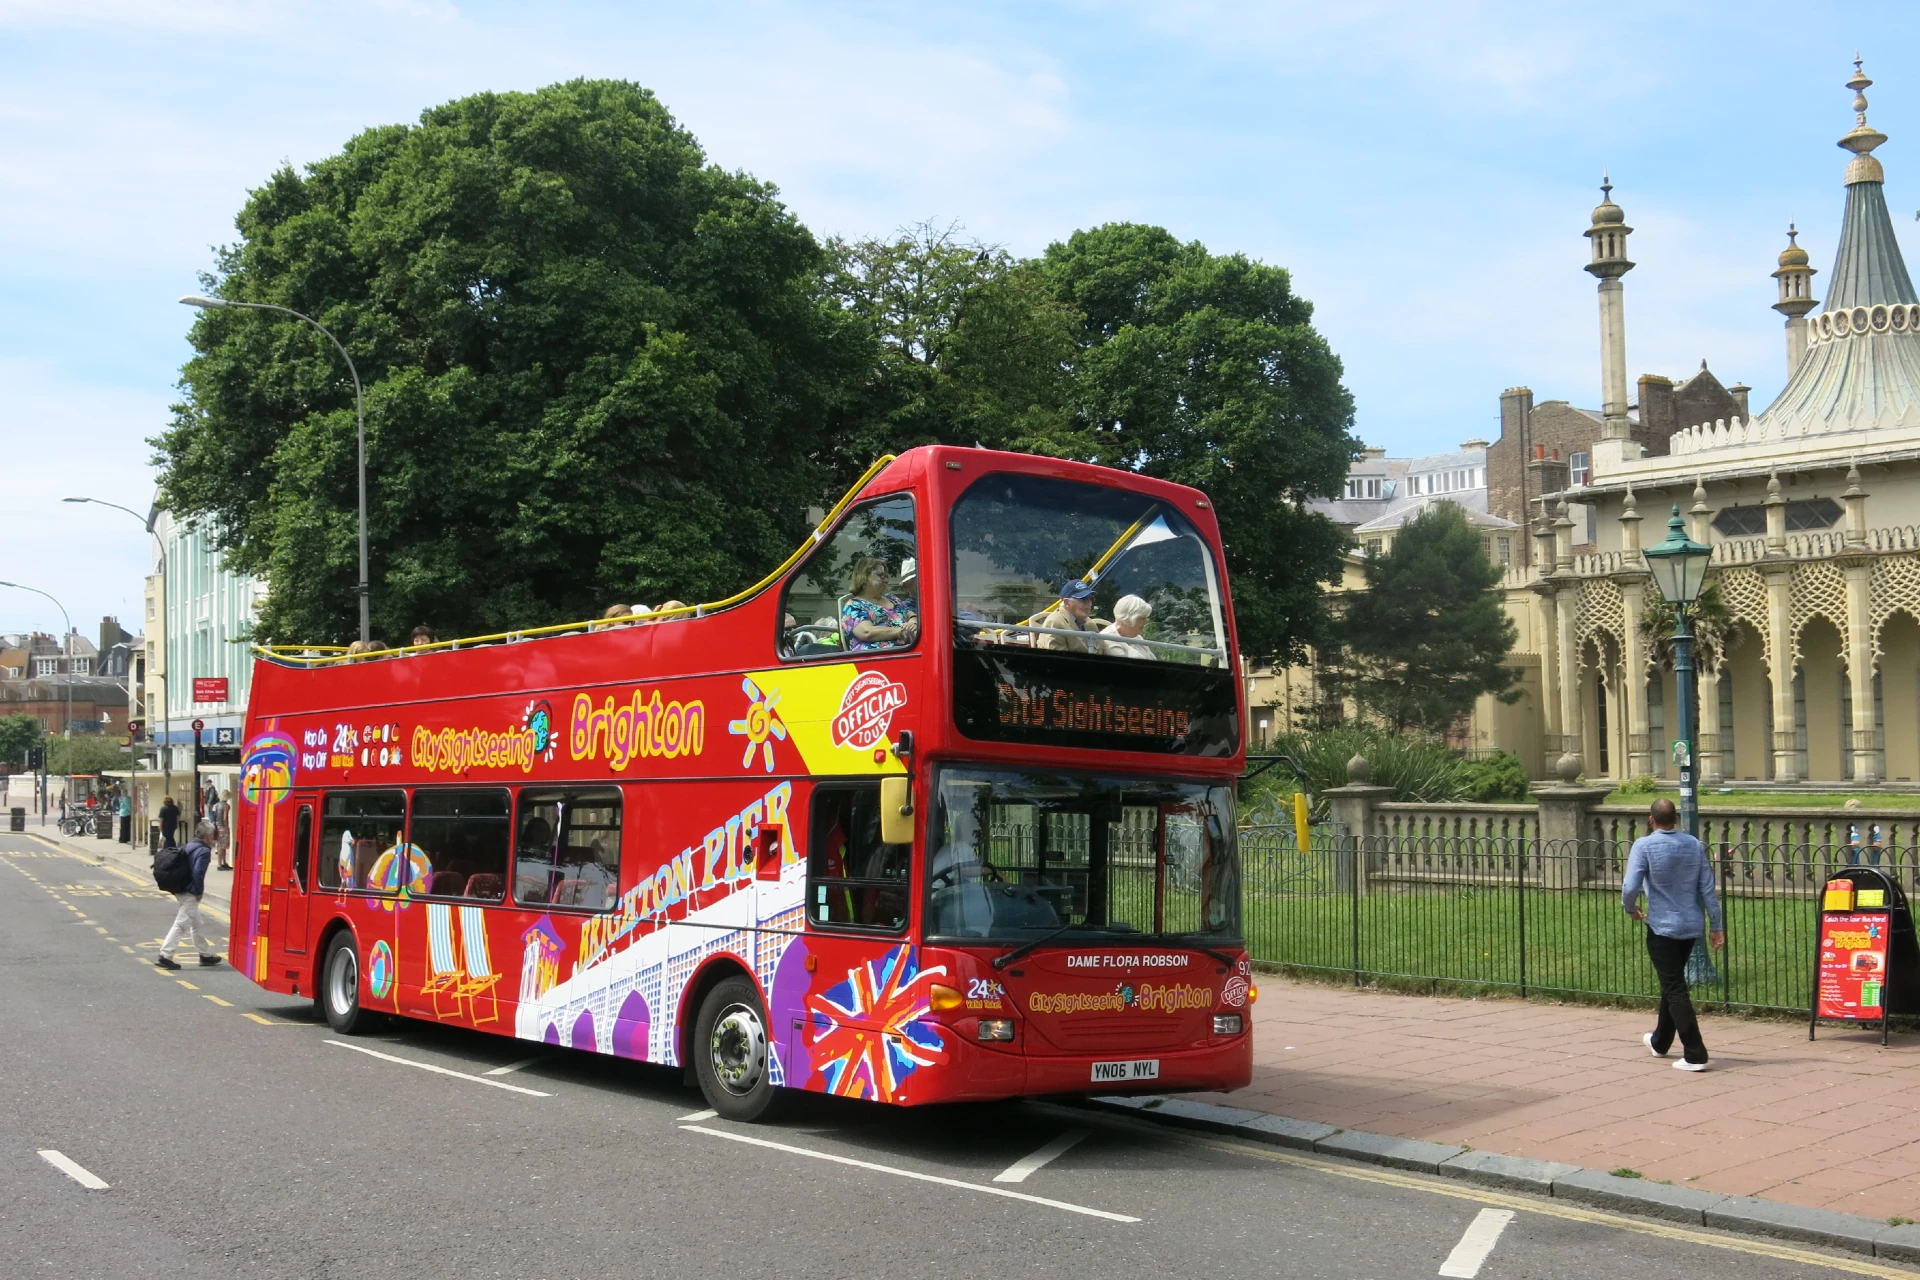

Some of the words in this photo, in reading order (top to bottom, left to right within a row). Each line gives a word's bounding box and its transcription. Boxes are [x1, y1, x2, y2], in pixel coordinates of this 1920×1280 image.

[845, 688, 855, 706] CITY
[854, 677, 886, 693] SIGHTSEEING
[838, 687, 902, 738] OFFICIAL
[998, 683, 1045, 725] City
[1053, 689, 1190, 738] Sightseeing
[304, 730, 317, 747] Hop
[317, 728, 328, 746] On
[571, 689, 704, 771] Brighton
[858, 718, 888, 743] TOUR
[302, 752, 315, 770] Hop
[315, 751, 328, 768] Off
[577, 846, 692, 975] BRIGHTON
[701, 780, 800, 891] PIER
[1067, 955, 1100, 968] DAME
[1103, 955, 1140, 967] FLORA
[1142, 954, 1188, 967] ROBSON
[967, 978, 988, 999] 24
[1139, 983, 1213, 1014] Brighton
[1095, 1063, 1127, 1079] YN06
[1133, 1062, 1156, 1077] NYL
